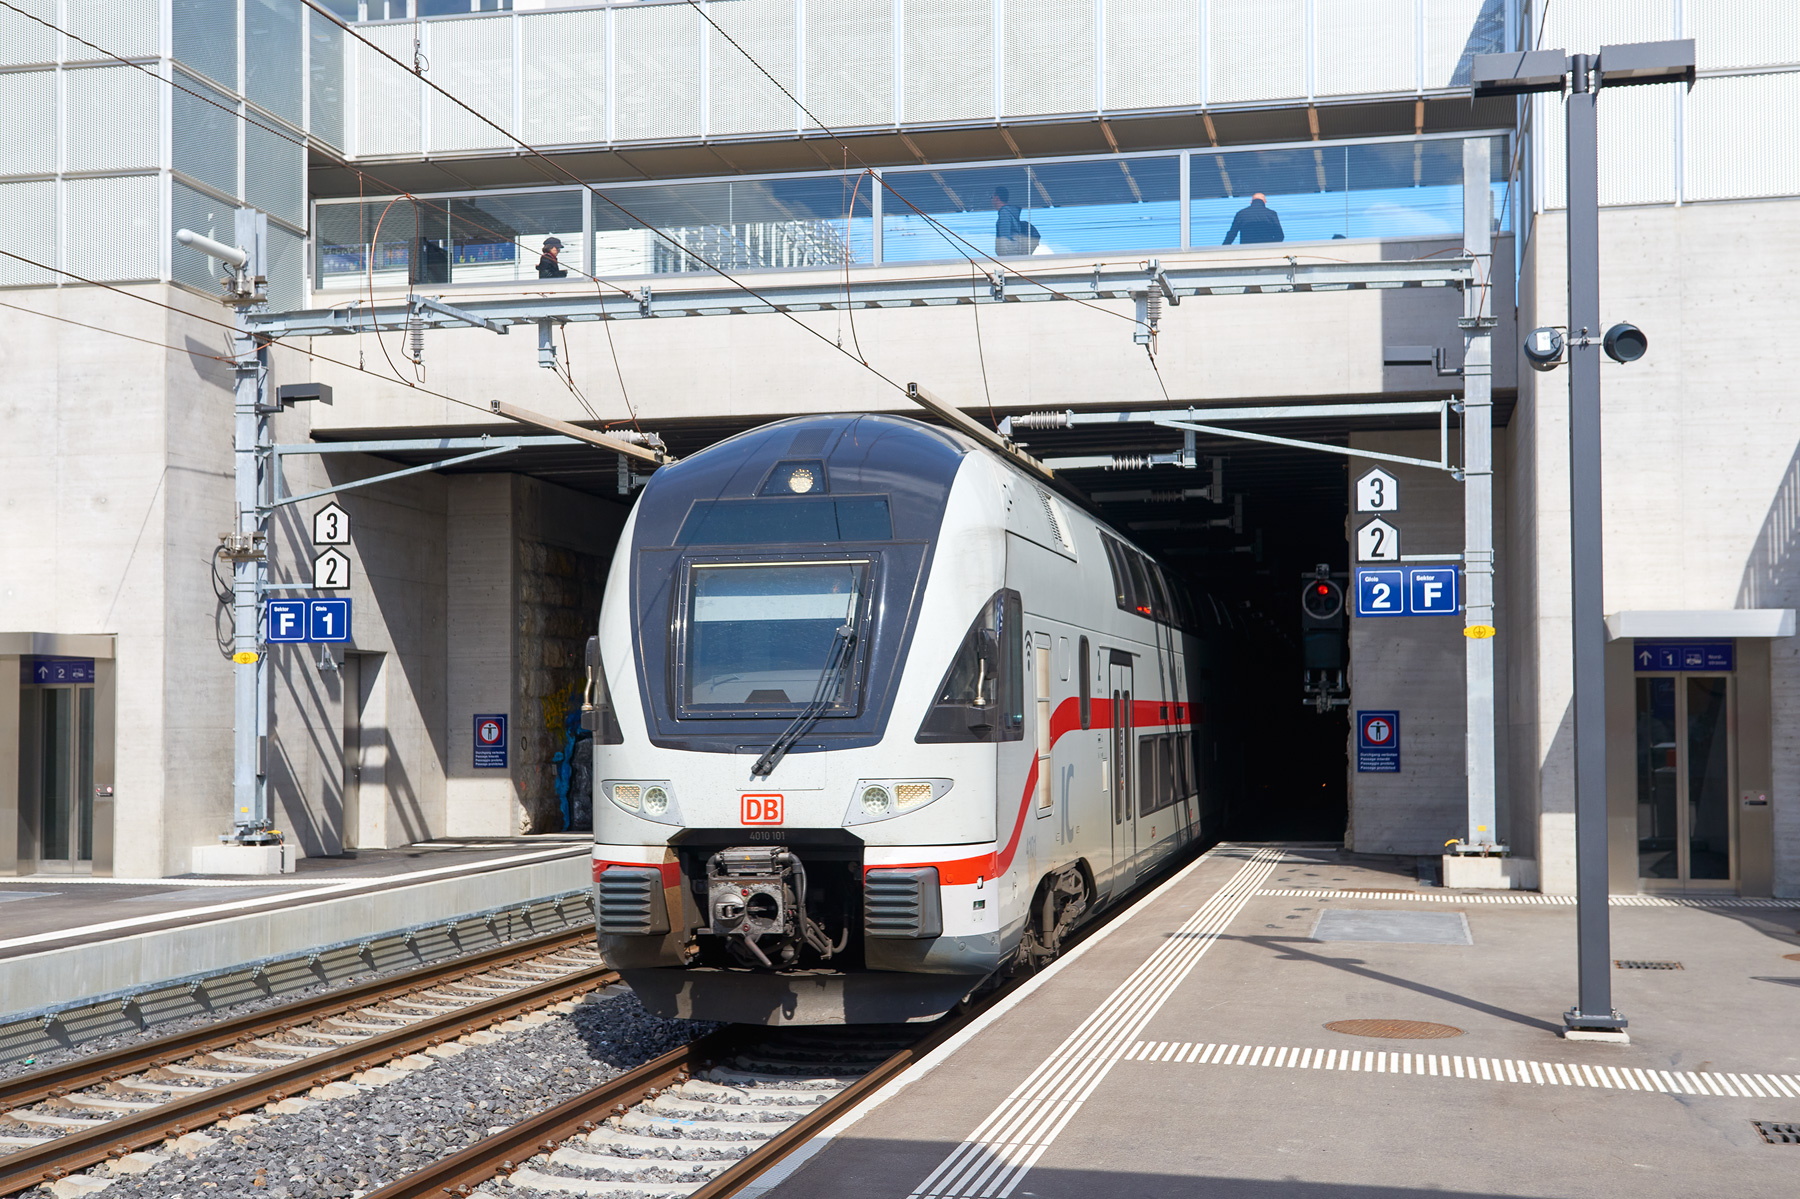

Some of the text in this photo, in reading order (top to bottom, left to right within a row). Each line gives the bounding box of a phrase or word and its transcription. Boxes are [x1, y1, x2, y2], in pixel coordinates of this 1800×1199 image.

[1370, 477, 1384, 508] 3
[326, 512, 338, 540] 3
[1370, 527, 1385, 557] 2
[326, 557, 338, 584] 2
[1372, 583, 1391, 608] 2
[1424, 582, 1443, 607] F
[280, 613, 296, 636] F
[322, 612, 333, 635] 1
[1666, 653, 1673, 666] 1
[57, 668, 65, 679] 2
[746, 799, 779, 820] DB
[1060, 763, 1075, 846] IC
[749, 831, 785, 841] 4010 101
